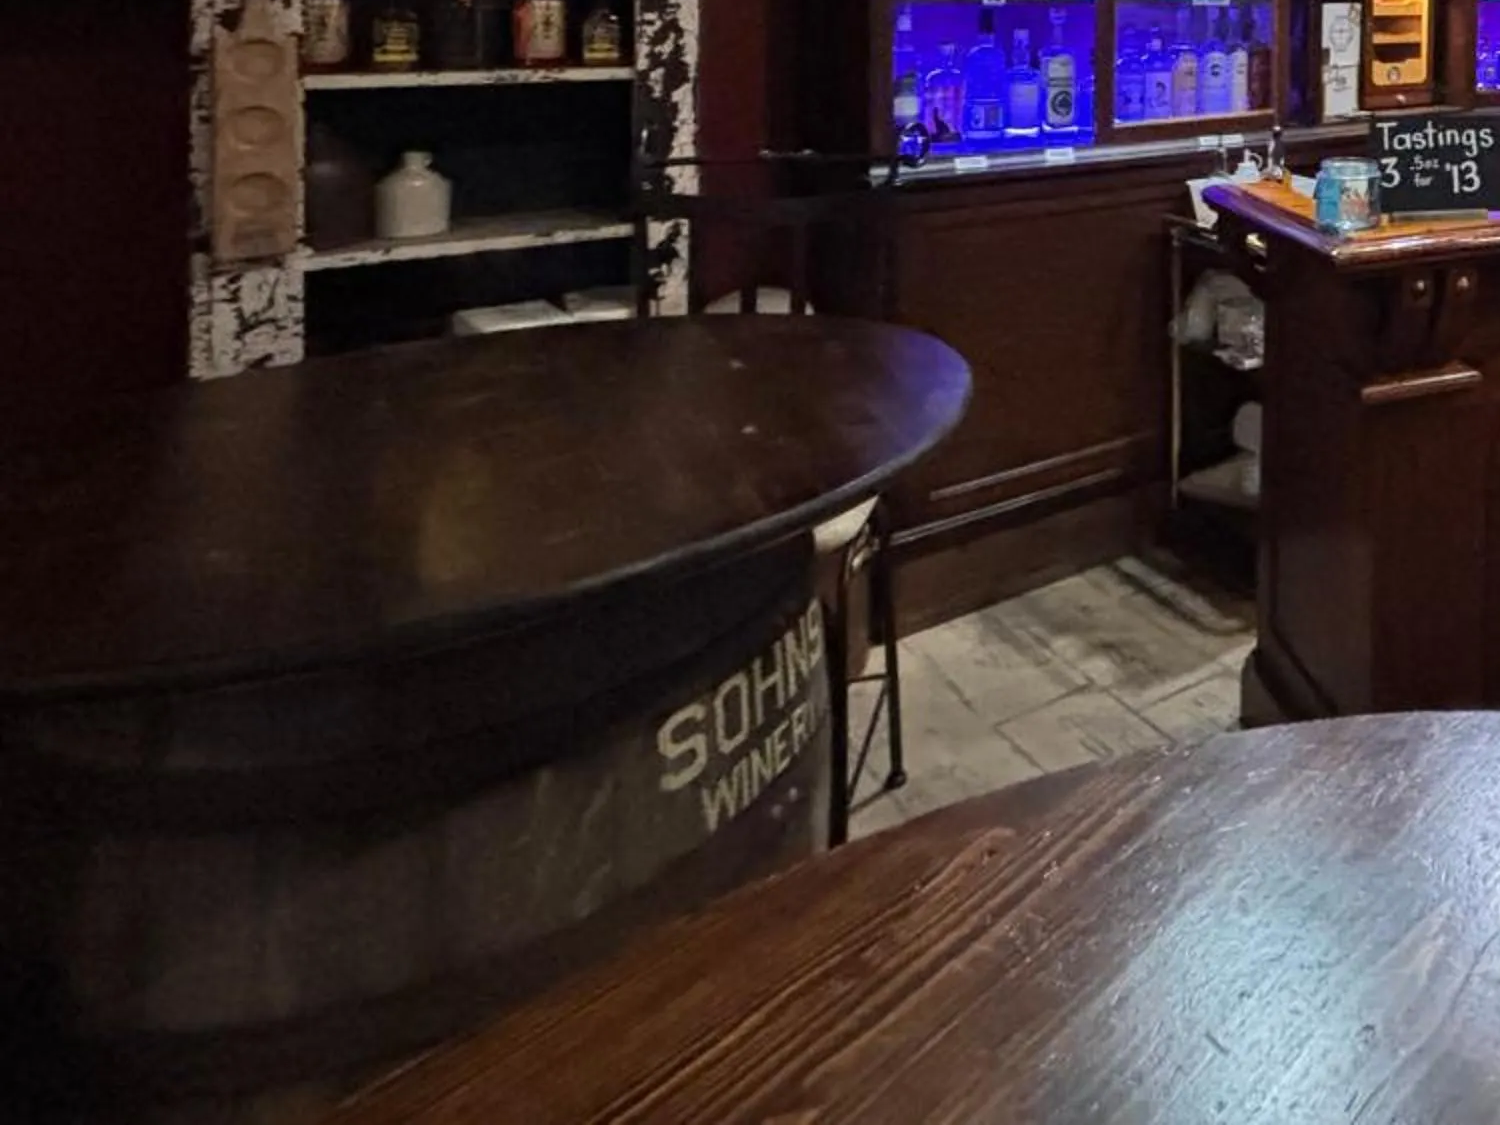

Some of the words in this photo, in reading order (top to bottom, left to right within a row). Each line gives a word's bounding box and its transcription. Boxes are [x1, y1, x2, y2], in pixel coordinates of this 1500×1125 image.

[1376, 120, 1494, 157] Tastings
[1380, 156, 1401, 188] 3
[1413, 172, 1433, 187] for
[656, 597, 823, 792] SOHNS
